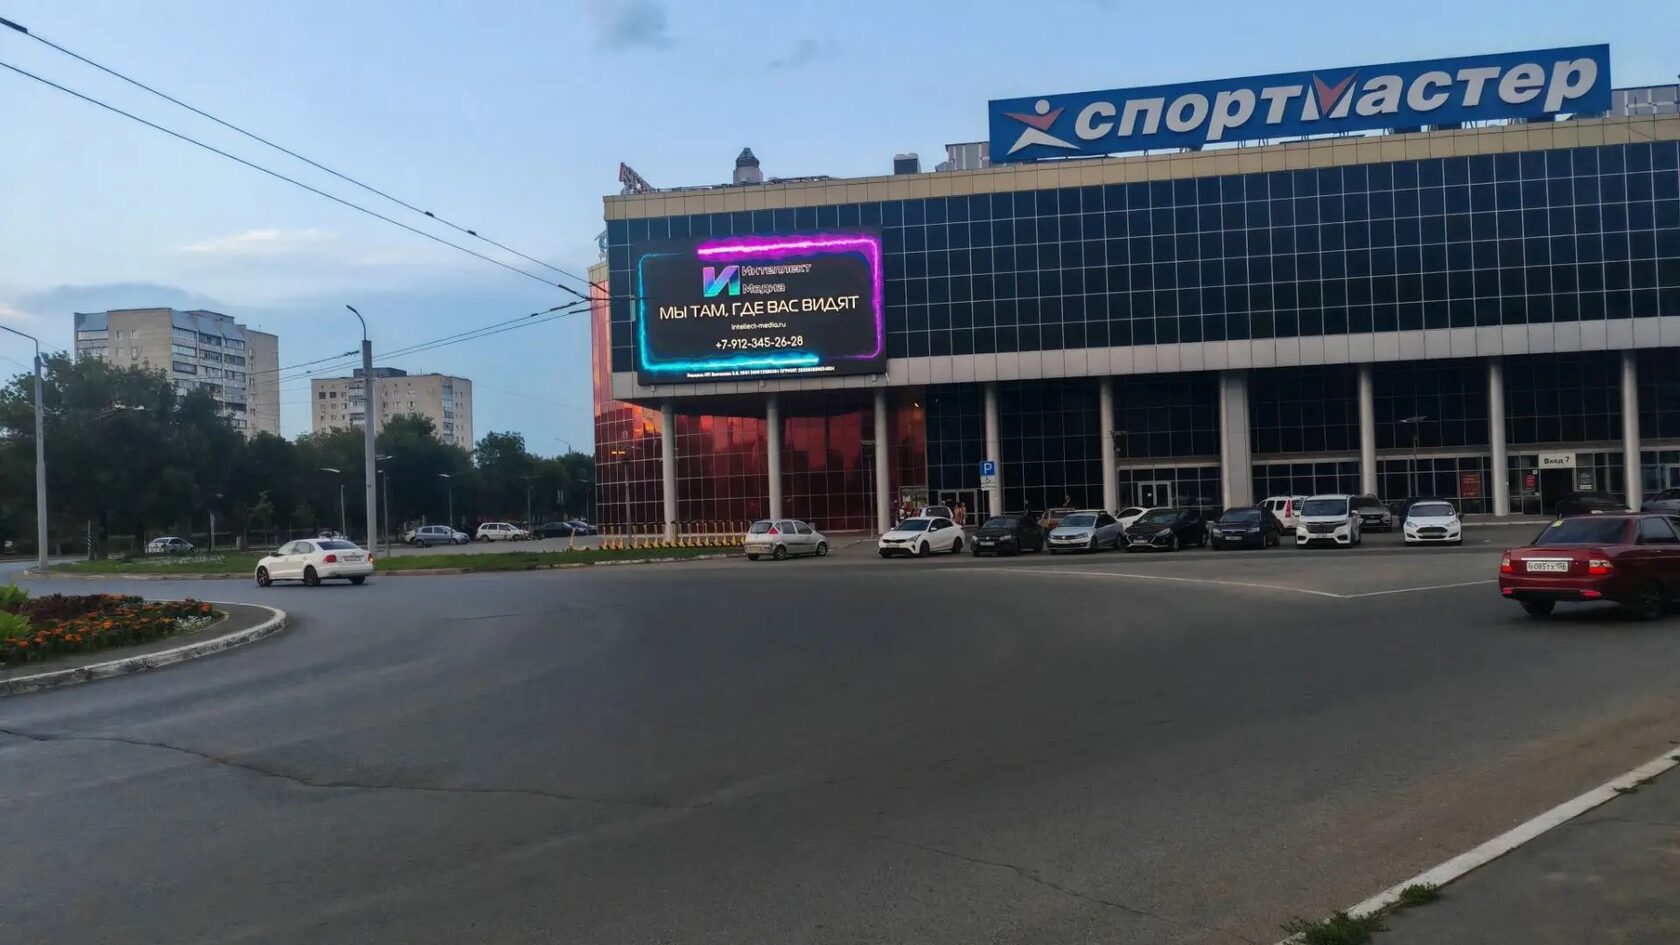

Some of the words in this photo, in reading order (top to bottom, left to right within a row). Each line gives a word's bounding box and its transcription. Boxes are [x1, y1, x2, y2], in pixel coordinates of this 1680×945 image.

[741, 264, 812, 276] Интеллект
[742, 283, 786, 294] Медиа
[659, 308, 687, 319] МЫ
[690, 304, 728, 318] ТАМ,
[732, 302, 763, 316] ГДЕ
[767, 299, 798, 312] ВАС
[802, 296, 859, 312] ВИДЯТ
[716, 336, 804, 350] +7-912-345-26-28
[1543, 457, 1564, 465] Вход
[984, 462, 992, 474] P
